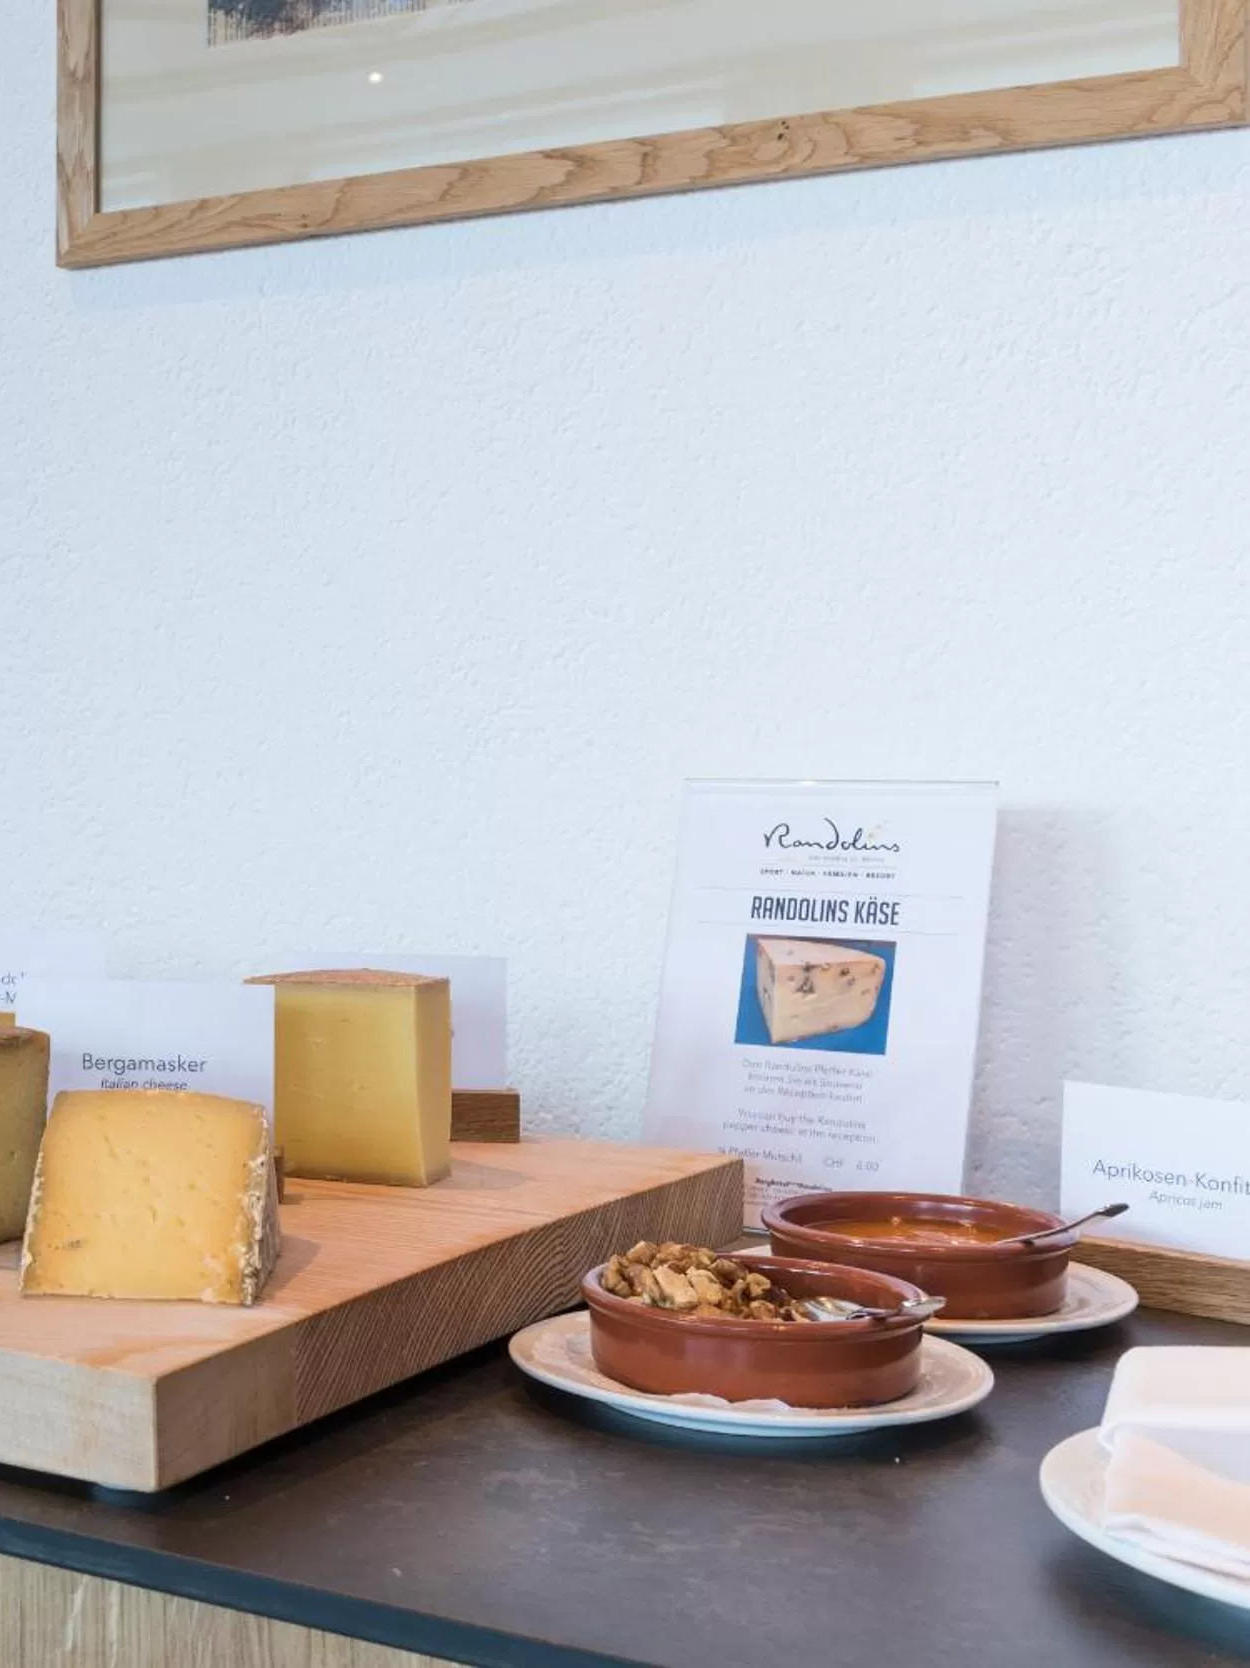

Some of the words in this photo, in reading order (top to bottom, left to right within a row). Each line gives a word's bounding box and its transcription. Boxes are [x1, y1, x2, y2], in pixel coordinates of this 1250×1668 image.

[764, 817, 900, 852] Randolins
[750, 896, 850, 923] RANDOLINS
[853, 896, 902, 926] KÄSE
[82, 1052, 209, 1076] Bergamasker
[101, 1078, 139, 1090] Italian
[142, 1079, 189, 1092] cheese
